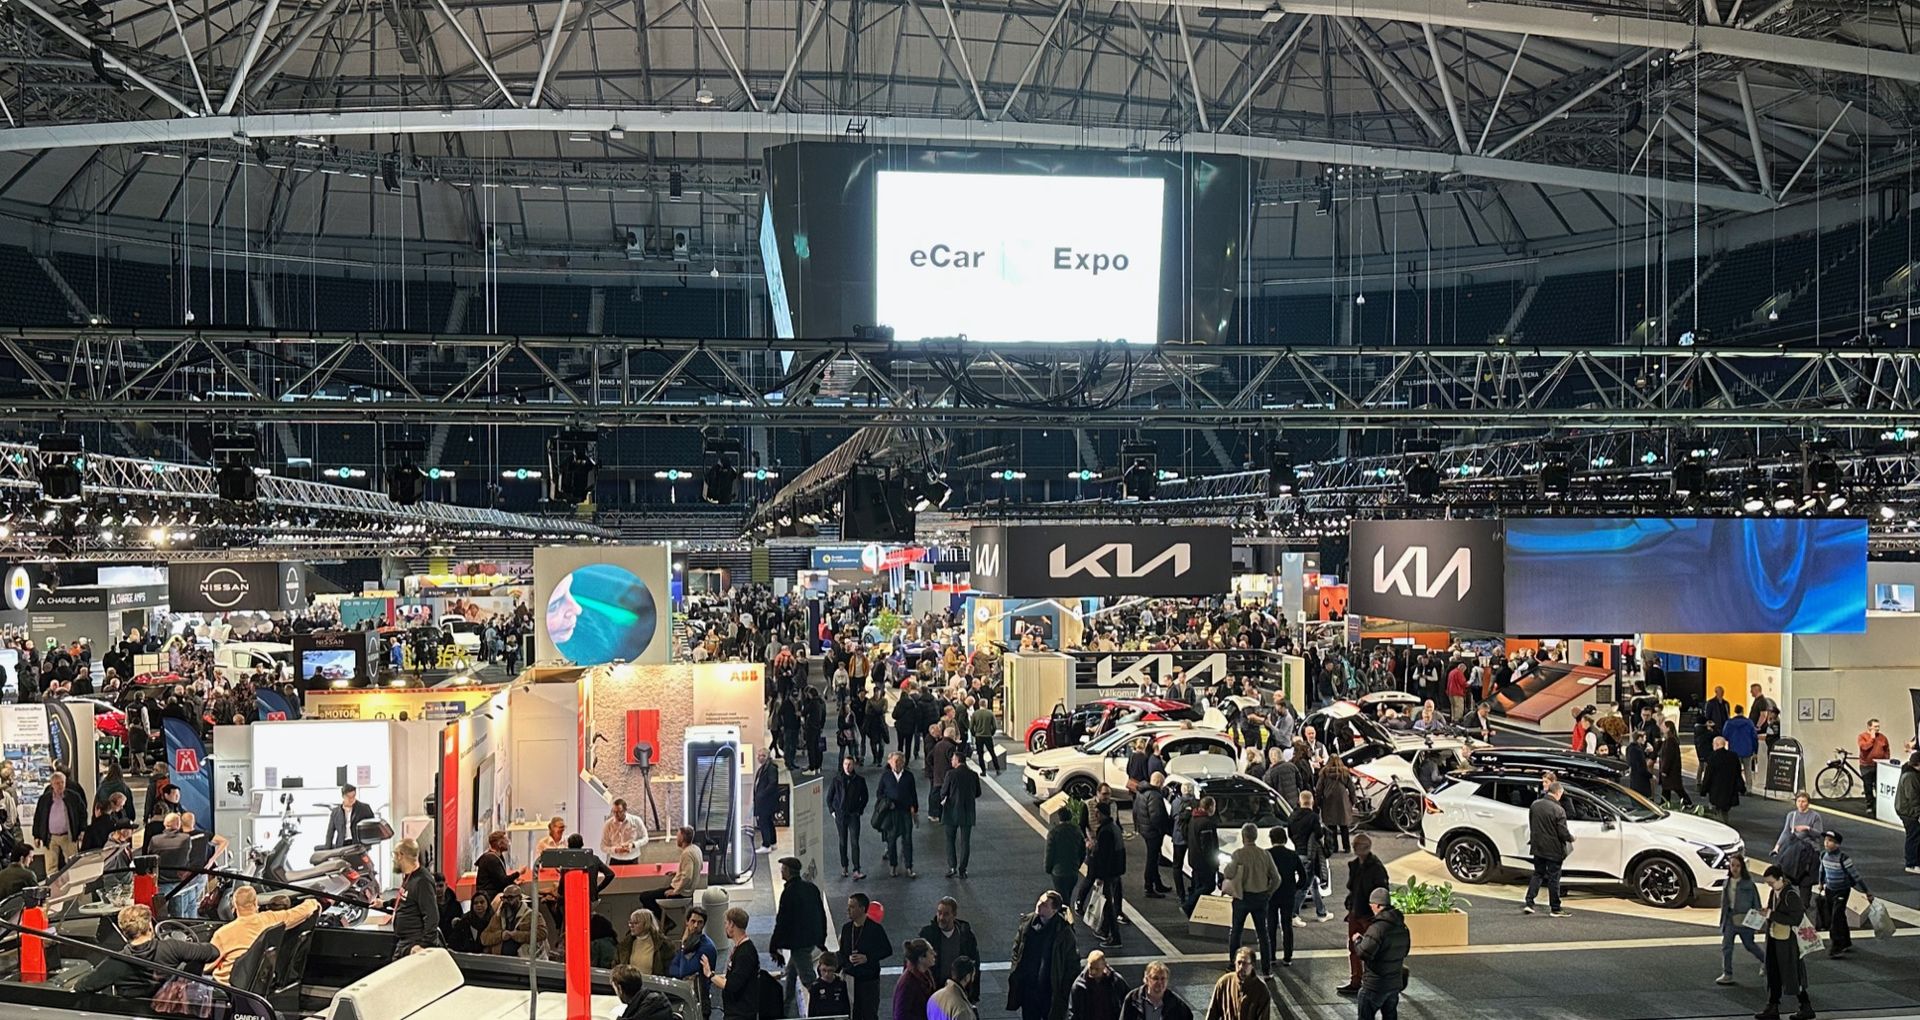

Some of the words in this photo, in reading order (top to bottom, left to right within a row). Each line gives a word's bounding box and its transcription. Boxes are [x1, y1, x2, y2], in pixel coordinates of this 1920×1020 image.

[909, 243, 986, 268] eCar
[1053, 247, 1130, 275] Expo
[975, 543, 1000, 578] KIA
[1049, 542, 1191, 578] KIA
[1373, 544, 1472, 601] KIA
[200, 583, 250, 591] NISSAN
[47, 596, 76, 604] CHARGE
[78, 596, 100, 604] AMPS
[116, 592, 134, 604] CHARGE
[729, 670, 758, 682] ABB
[1096, 652, 1228, 687] KIA
[1098, 687, 1136, 697] Välkomm
[324, 709, 356, 719] MOTOR
